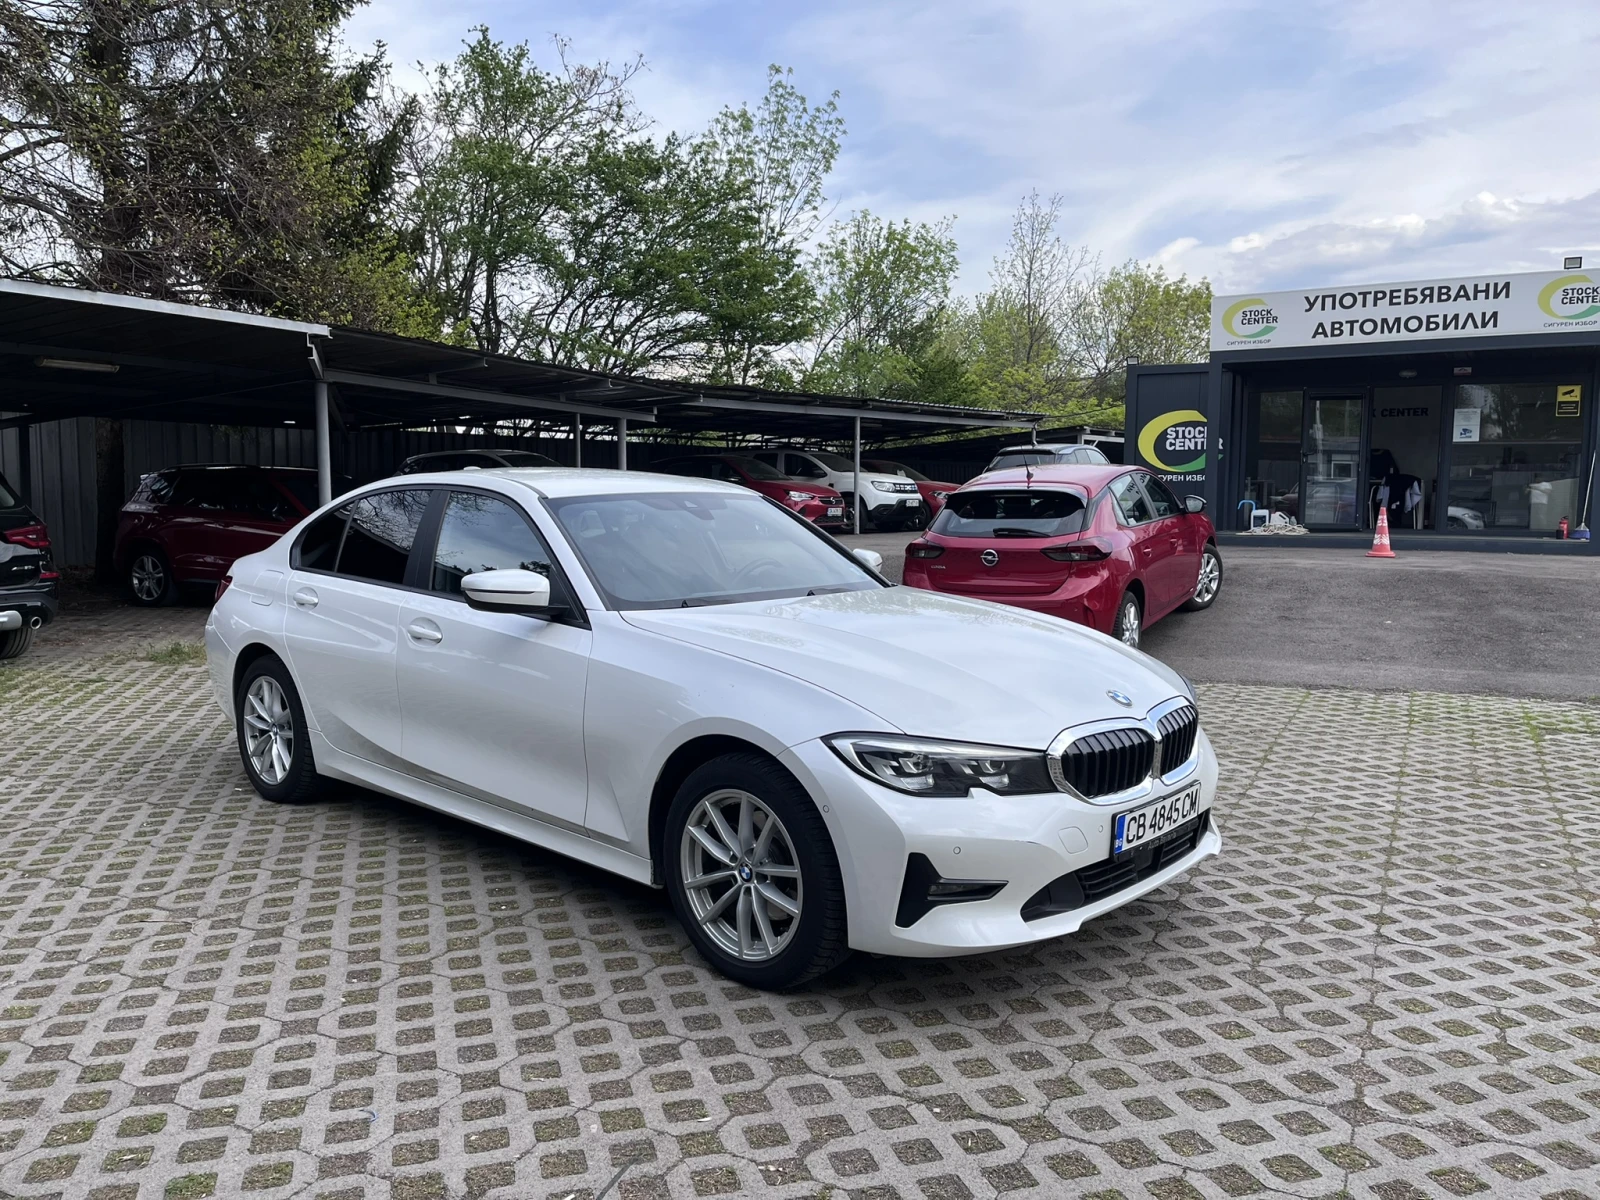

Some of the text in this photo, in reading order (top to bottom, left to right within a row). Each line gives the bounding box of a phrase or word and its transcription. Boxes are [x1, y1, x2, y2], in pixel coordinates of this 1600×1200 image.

[1562, 286, 1600, 296] STOCK
[1304, 281, 1511, 313] УПОТРЕБЯВАНИ
[1561, 295, 1600, 305] CENTE
[1241, 308, 1273, 318] STOCK
[1241, 316, 1278, 326] CENTER
[1311, 311, 1499, 339] АВТОМОБИЛИ
[1380, 407, 1429, 418] CENTER
[1185, 474, 1206, 482] ИЗБ
[1126, 812, 1147, 844] CB
[1149, 797, 1181, 834] 4845
[1181, 788, 1199, 819] CM
